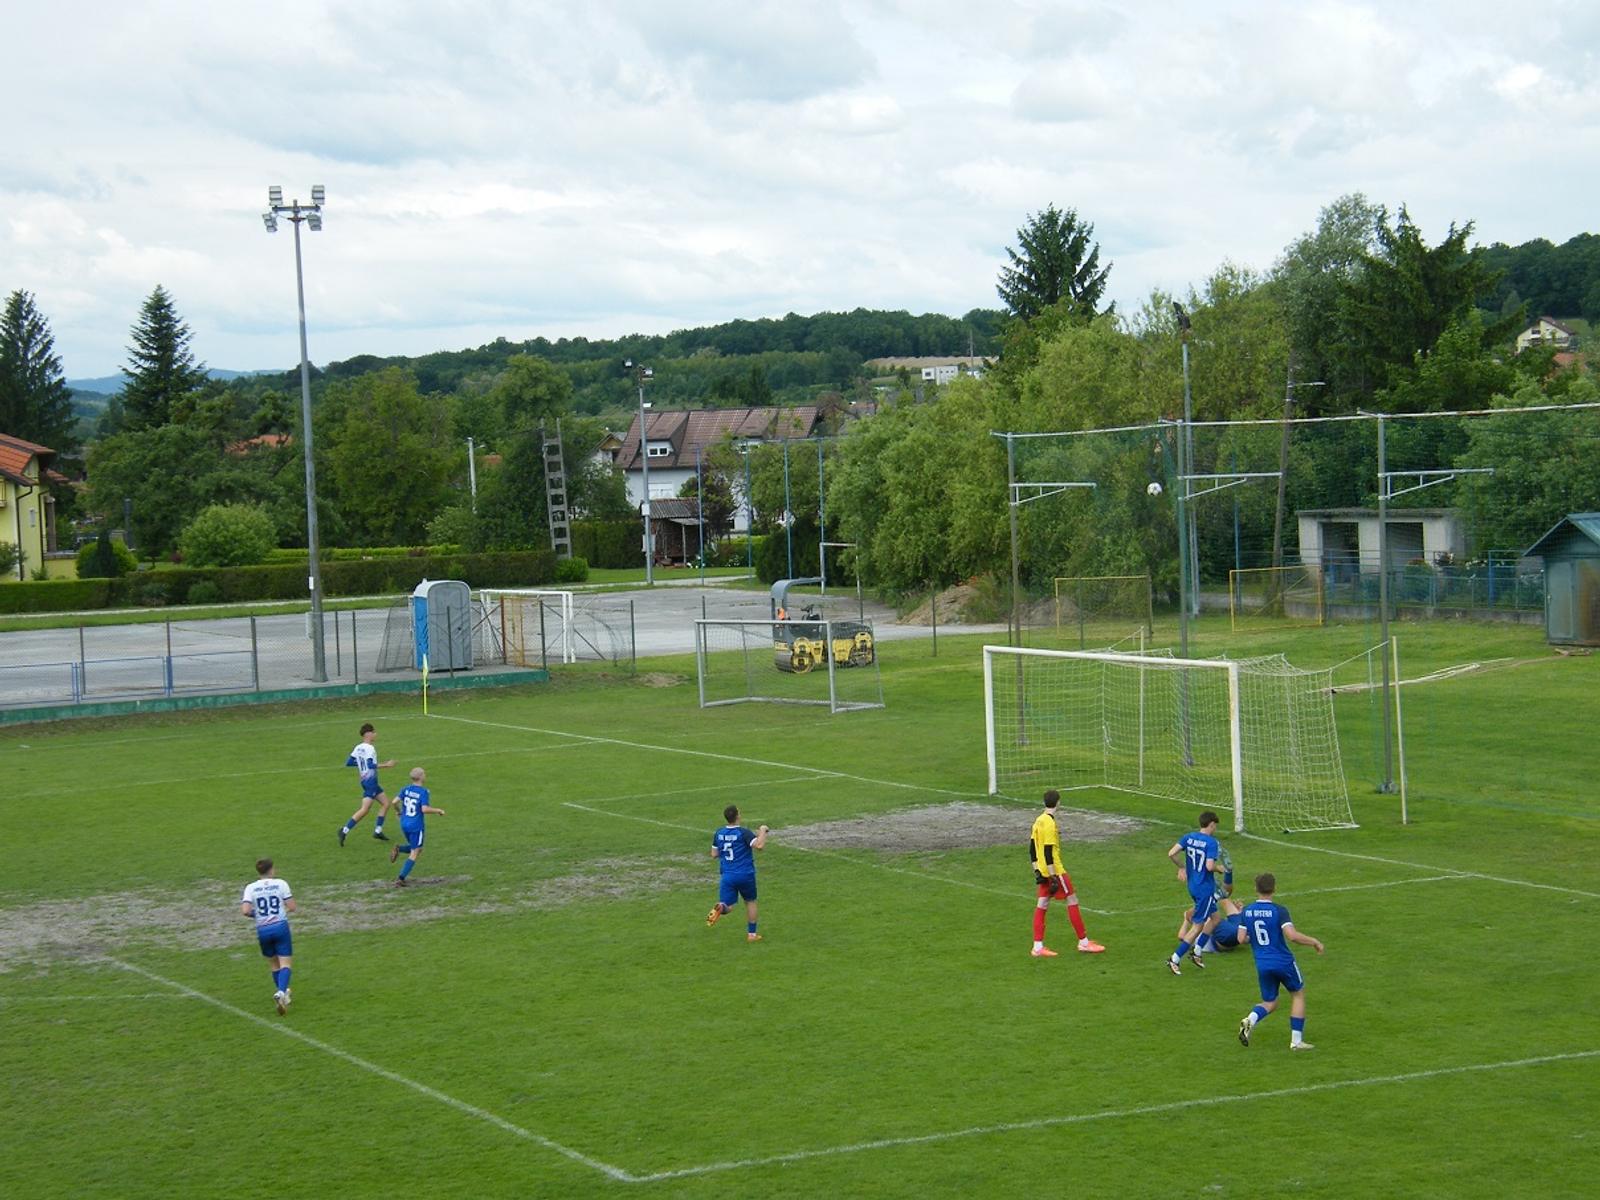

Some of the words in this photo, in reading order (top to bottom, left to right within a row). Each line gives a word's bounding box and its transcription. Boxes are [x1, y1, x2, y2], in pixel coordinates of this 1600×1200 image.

[723, 842, 734, 861] 5
[256, 895, 280, 916] 99
[1254, 920, 1270, 946] 6
